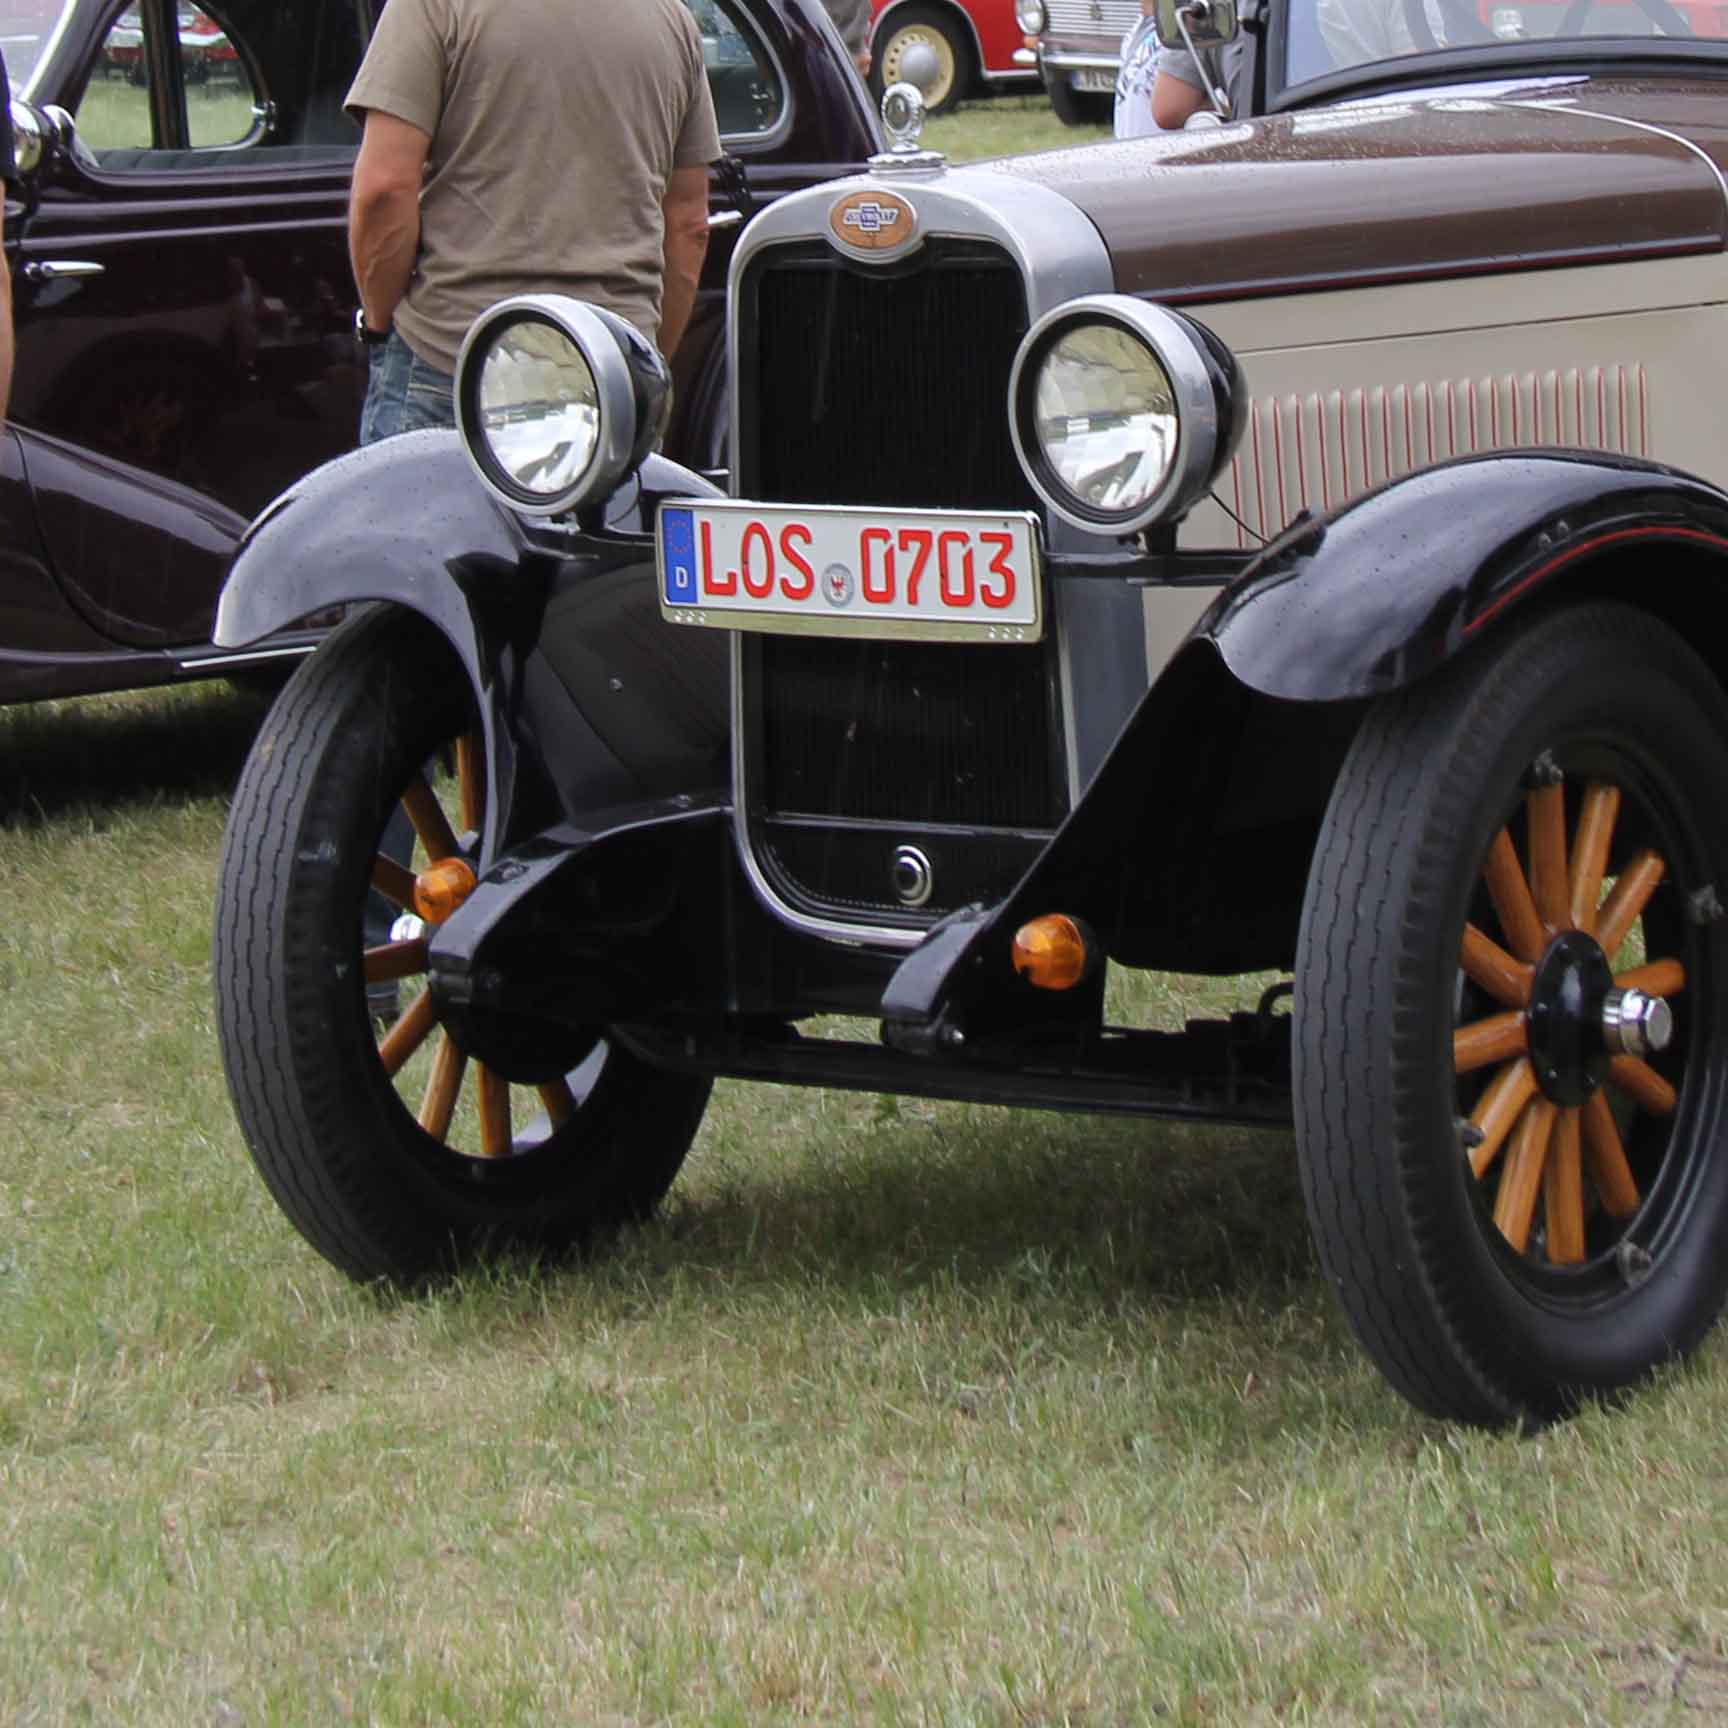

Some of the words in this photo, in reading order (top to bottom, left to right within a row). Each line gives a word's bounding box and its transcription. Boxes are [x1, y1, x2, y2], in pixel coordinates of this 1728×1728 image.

[676, 566, 689, 588] D
[700, 520, 815, 601] LOS
[860, 527, 1017, 609] 0703
